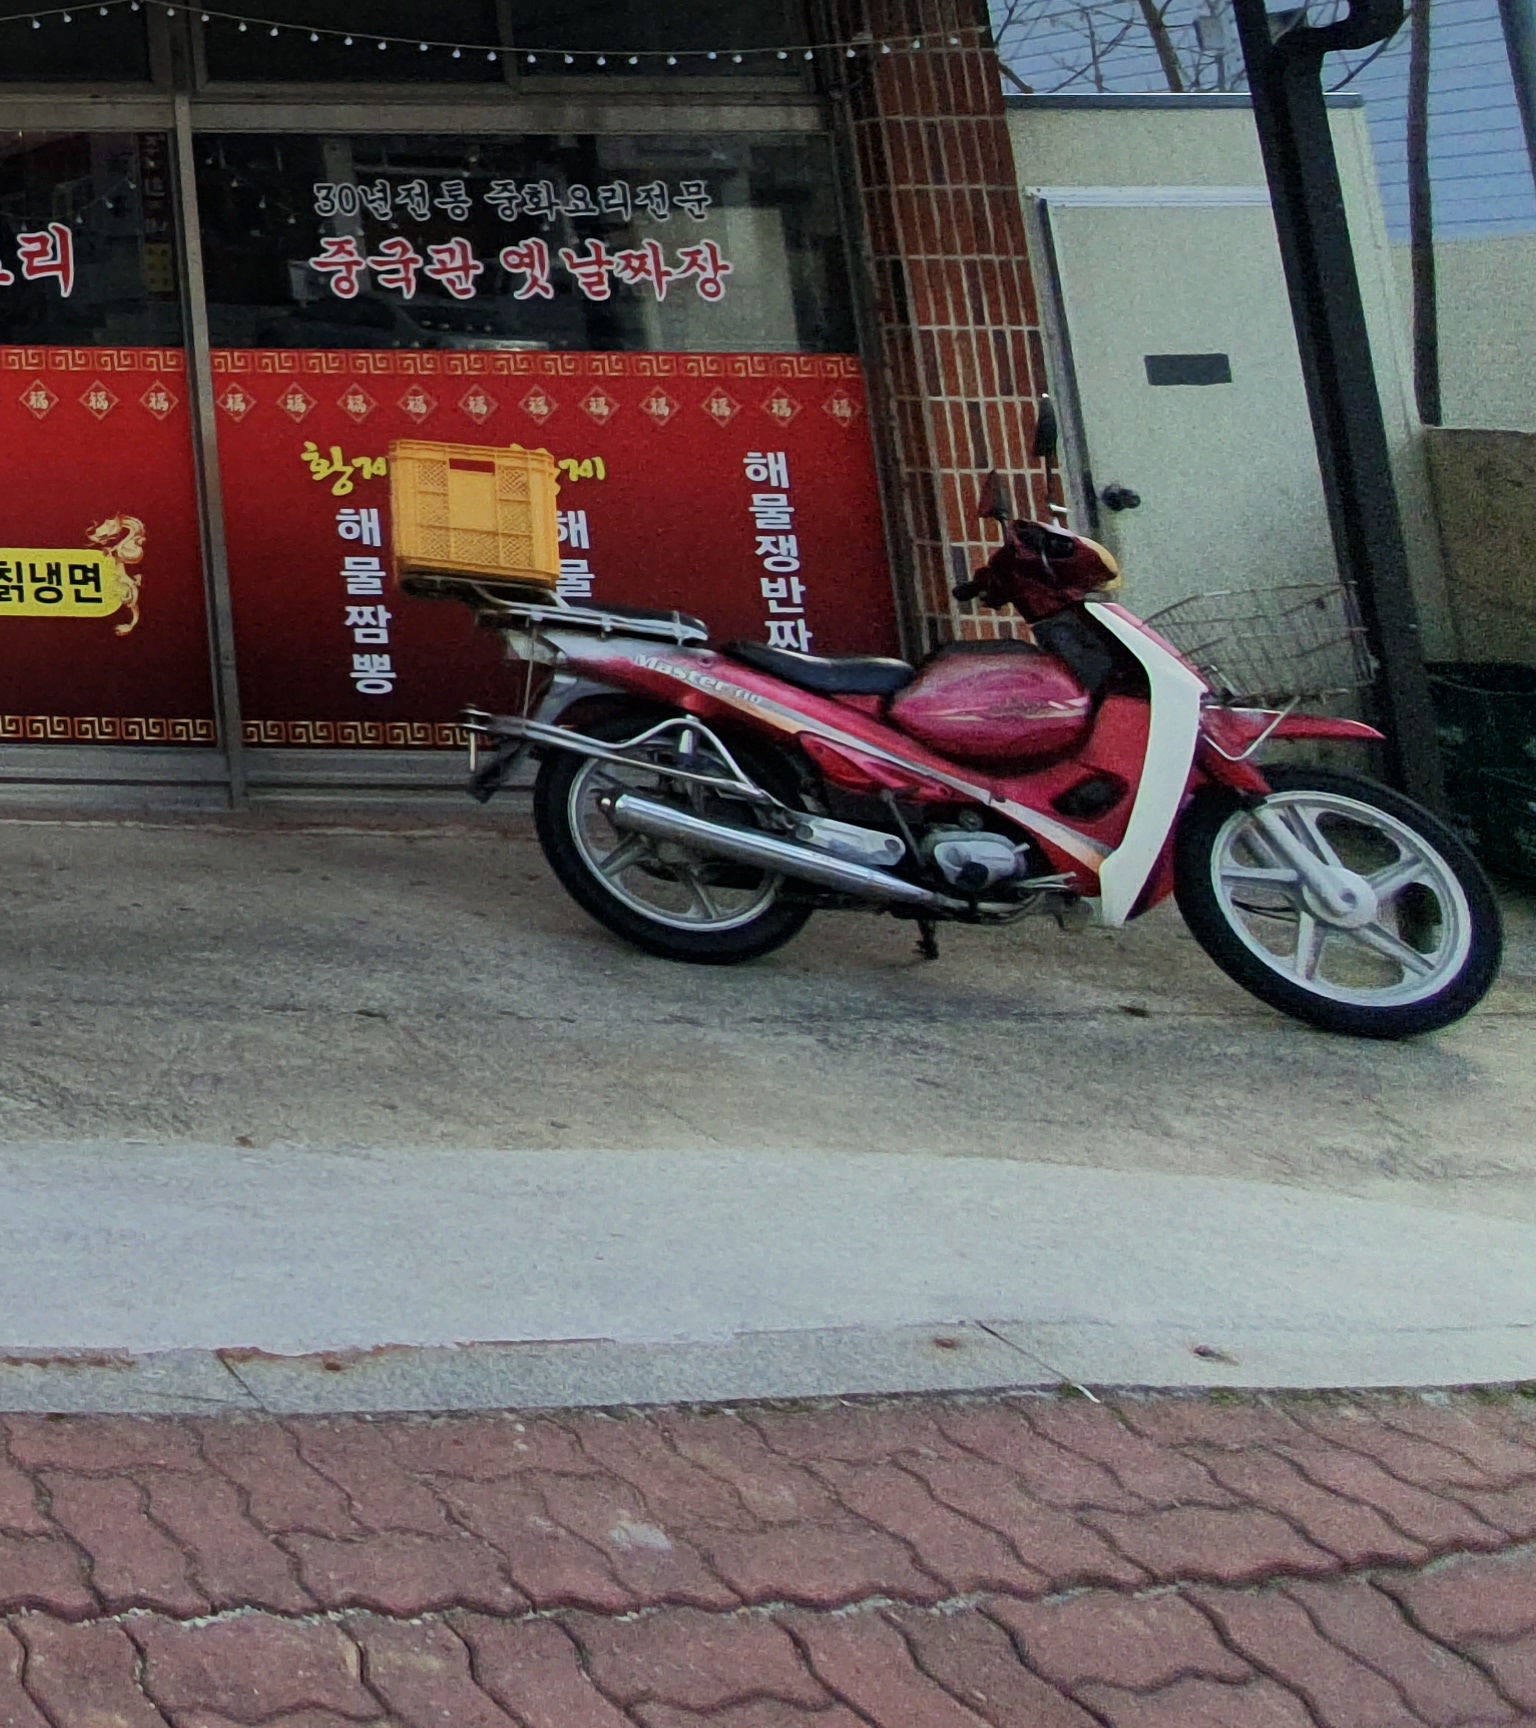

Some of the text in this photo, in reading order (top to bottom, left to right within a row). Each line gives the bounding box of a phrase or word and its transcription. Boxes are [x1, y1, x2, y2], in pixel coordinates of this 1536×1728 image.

[312, 179, 713, 222] 30년전통 중화요리전문
[308, 234, 733, 303] 중국관 옛날짜장
[742, 450, 813, 654] 해물쟁반짜
[334, 507, 398, 696] 해물짬뽕
[633, 653, 729, 692] Master
